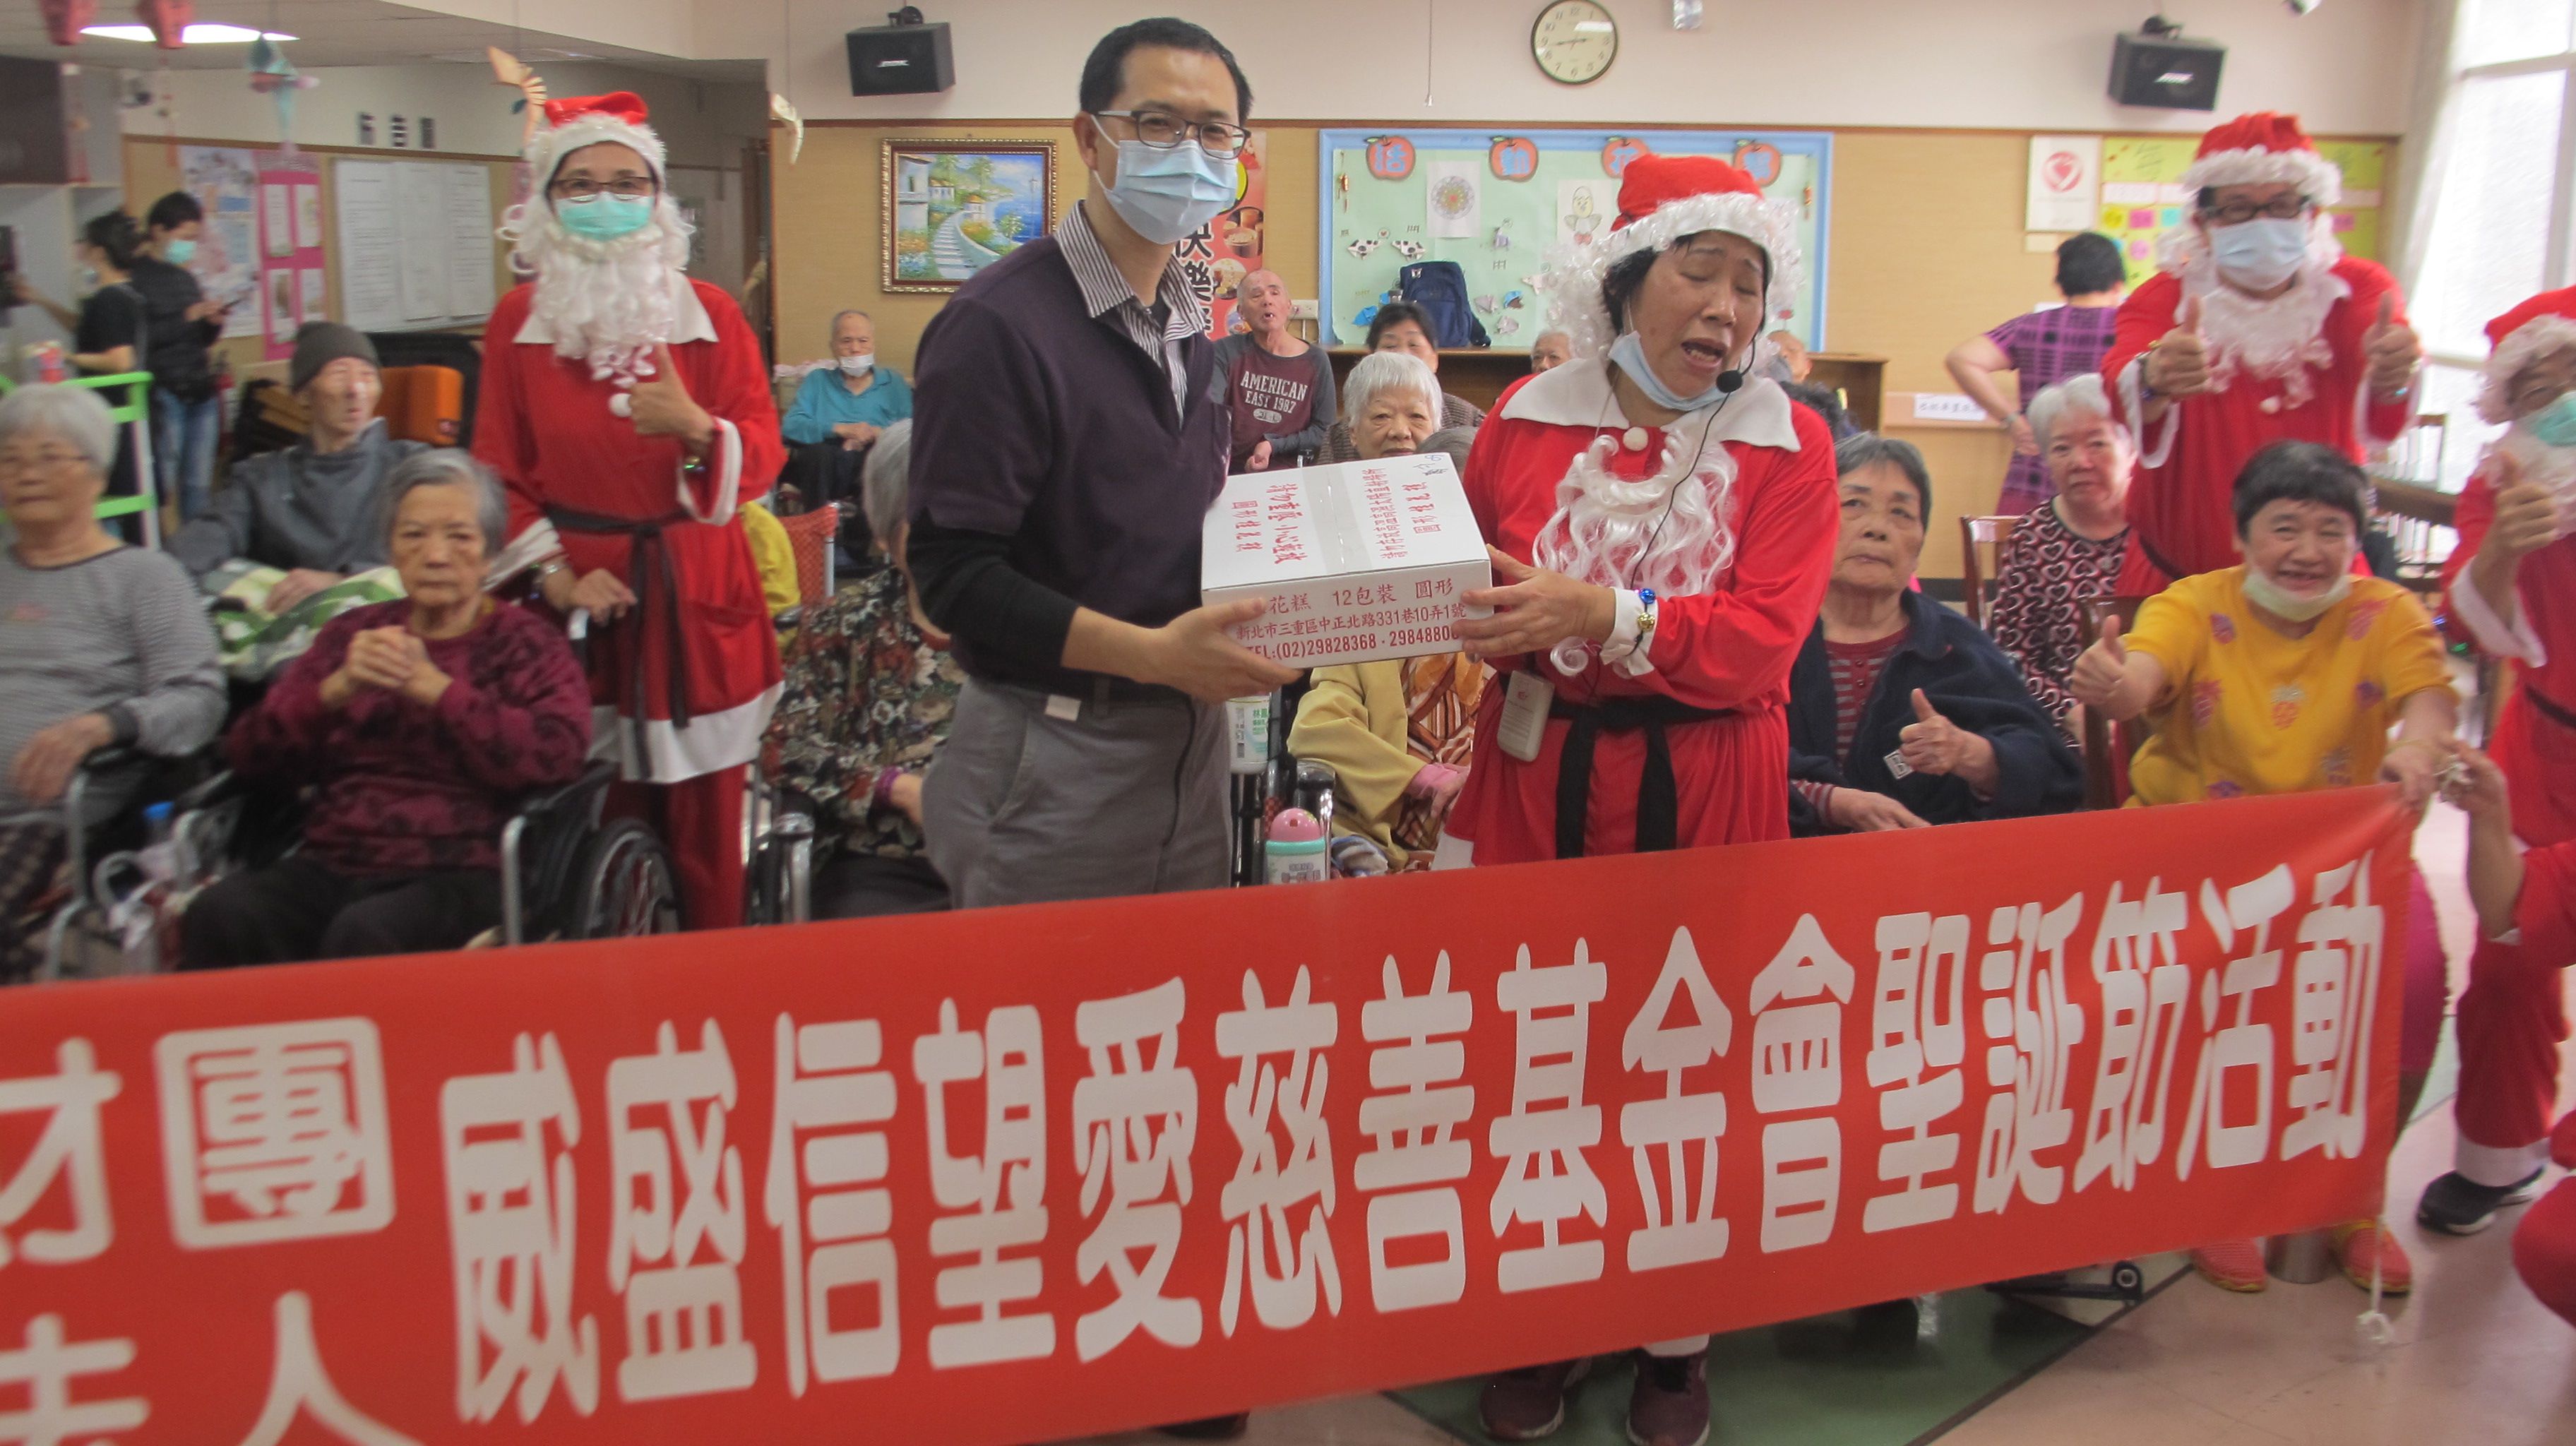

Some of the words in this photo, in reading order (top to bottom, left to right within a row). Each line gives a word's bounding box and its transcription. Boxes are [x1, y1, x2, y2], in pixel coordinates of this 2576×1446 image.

[1240, 370, 1308, 402] AMERICAN
[1244, 390, 1271, 408] EAST
[1265, 592, 1312, 614] 花糕
[1332, 583, 1397, 607] 12包裝
[1414, 578, 1454, 599] 圓形
[1236, 602, 1467, 640] 新北市三重區中正北路331巷10弄1號
[439, 849, 2385, 1426] 威盛信望愛慈善基金會聖誕節活動
